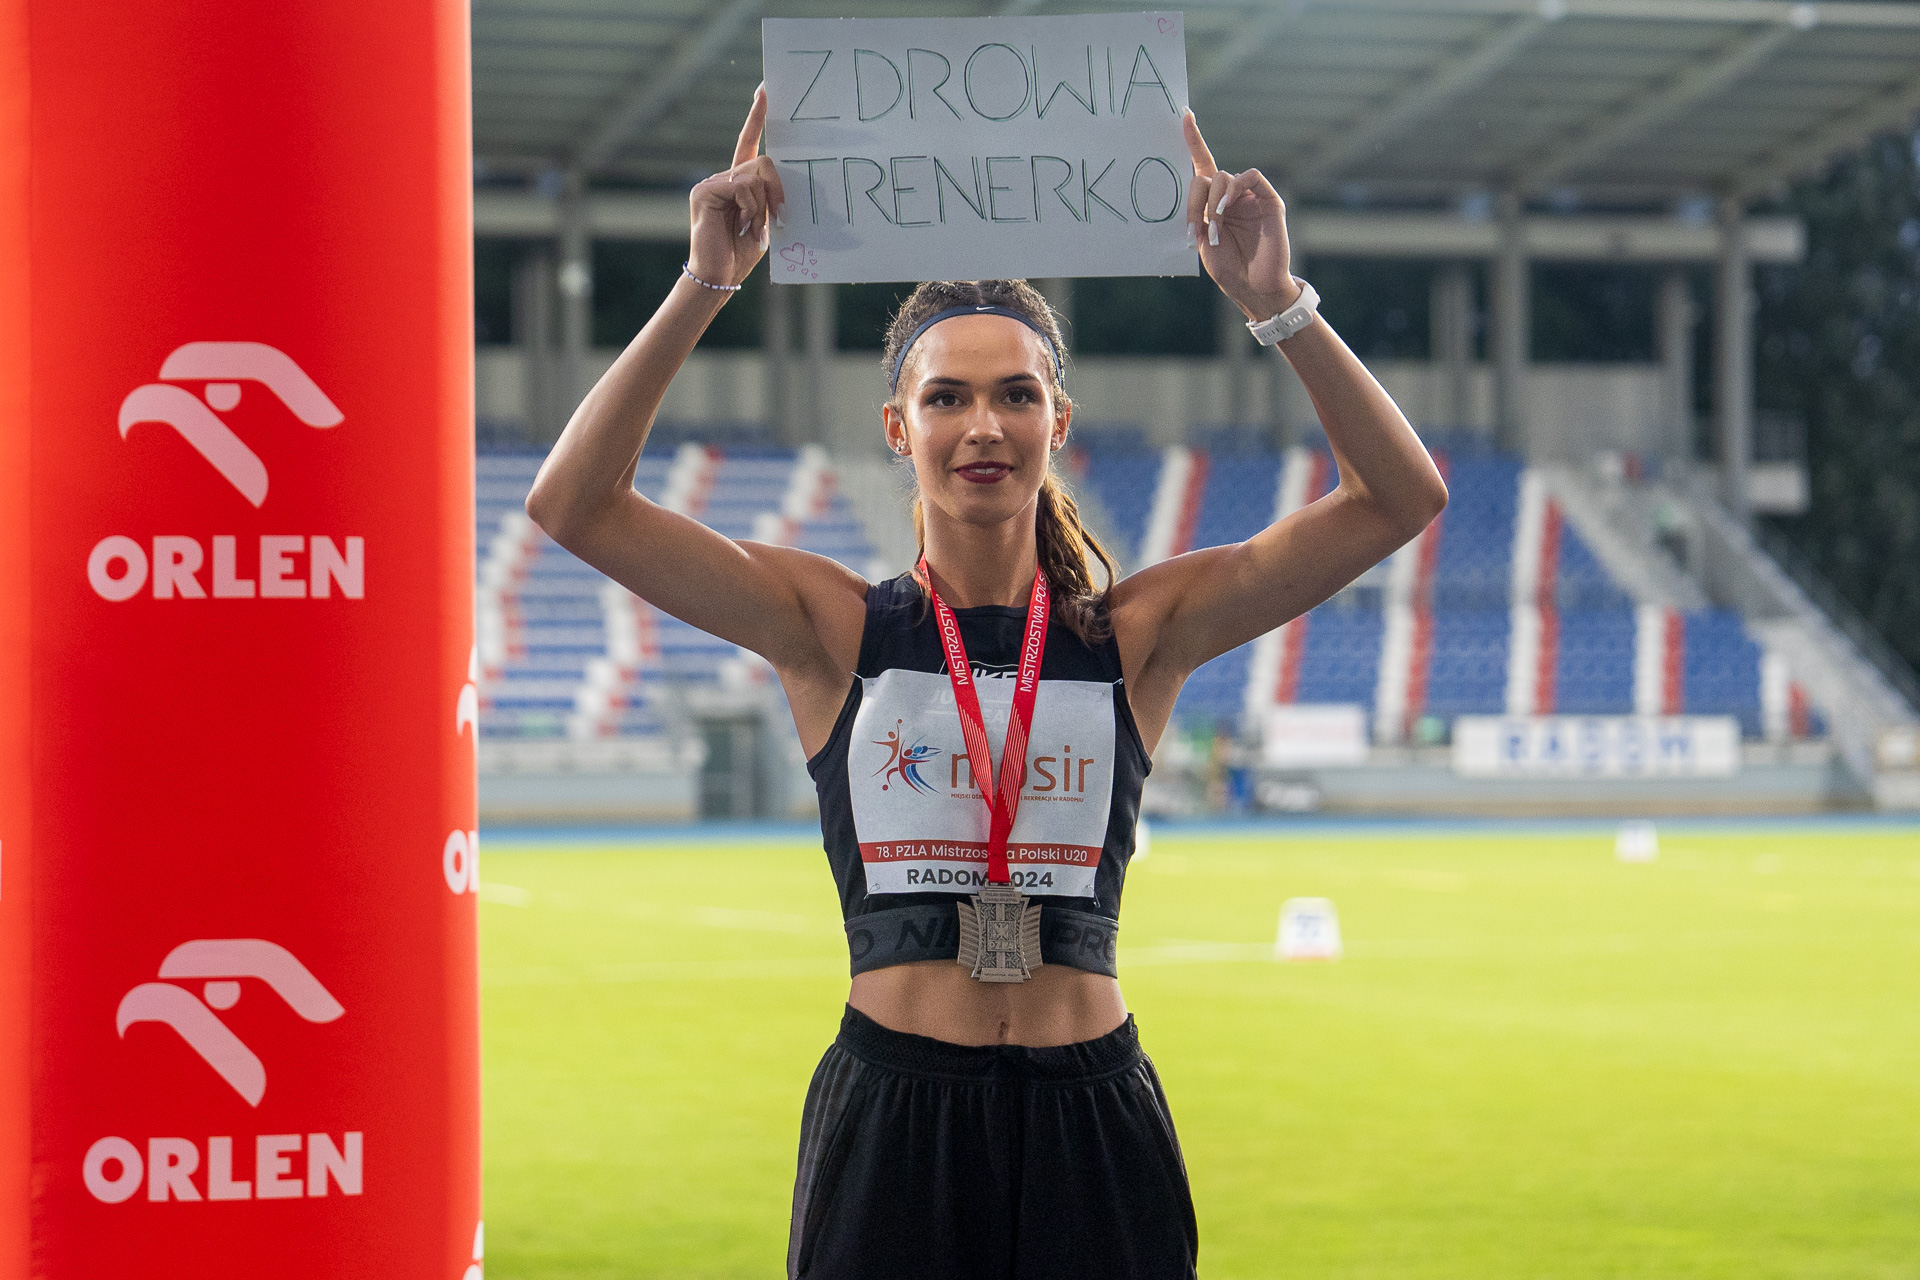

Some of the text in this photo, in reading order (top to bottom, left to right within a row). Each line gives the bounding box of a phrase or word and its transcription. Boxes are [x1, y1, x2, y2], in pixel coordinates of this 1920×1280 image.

[787, 43, 1181, 121] ZDROWIA
[780, 155, 1183, 228] TRENERKO
[87, 534, 365, 602] ORLEN
[936, 594, 969, 686] MISTRZOSTW
[1020, 573, 1047, 692] MISTRZOSTWA POLS
[951, 745, 1094, 792] msir
[876, 845, 1088, 862] 78. PZLA Mistrzosa Polski U20
[907, 869, 1054, 888] RADOM 024
[83, 1131, 364, 1204] ORLEN
